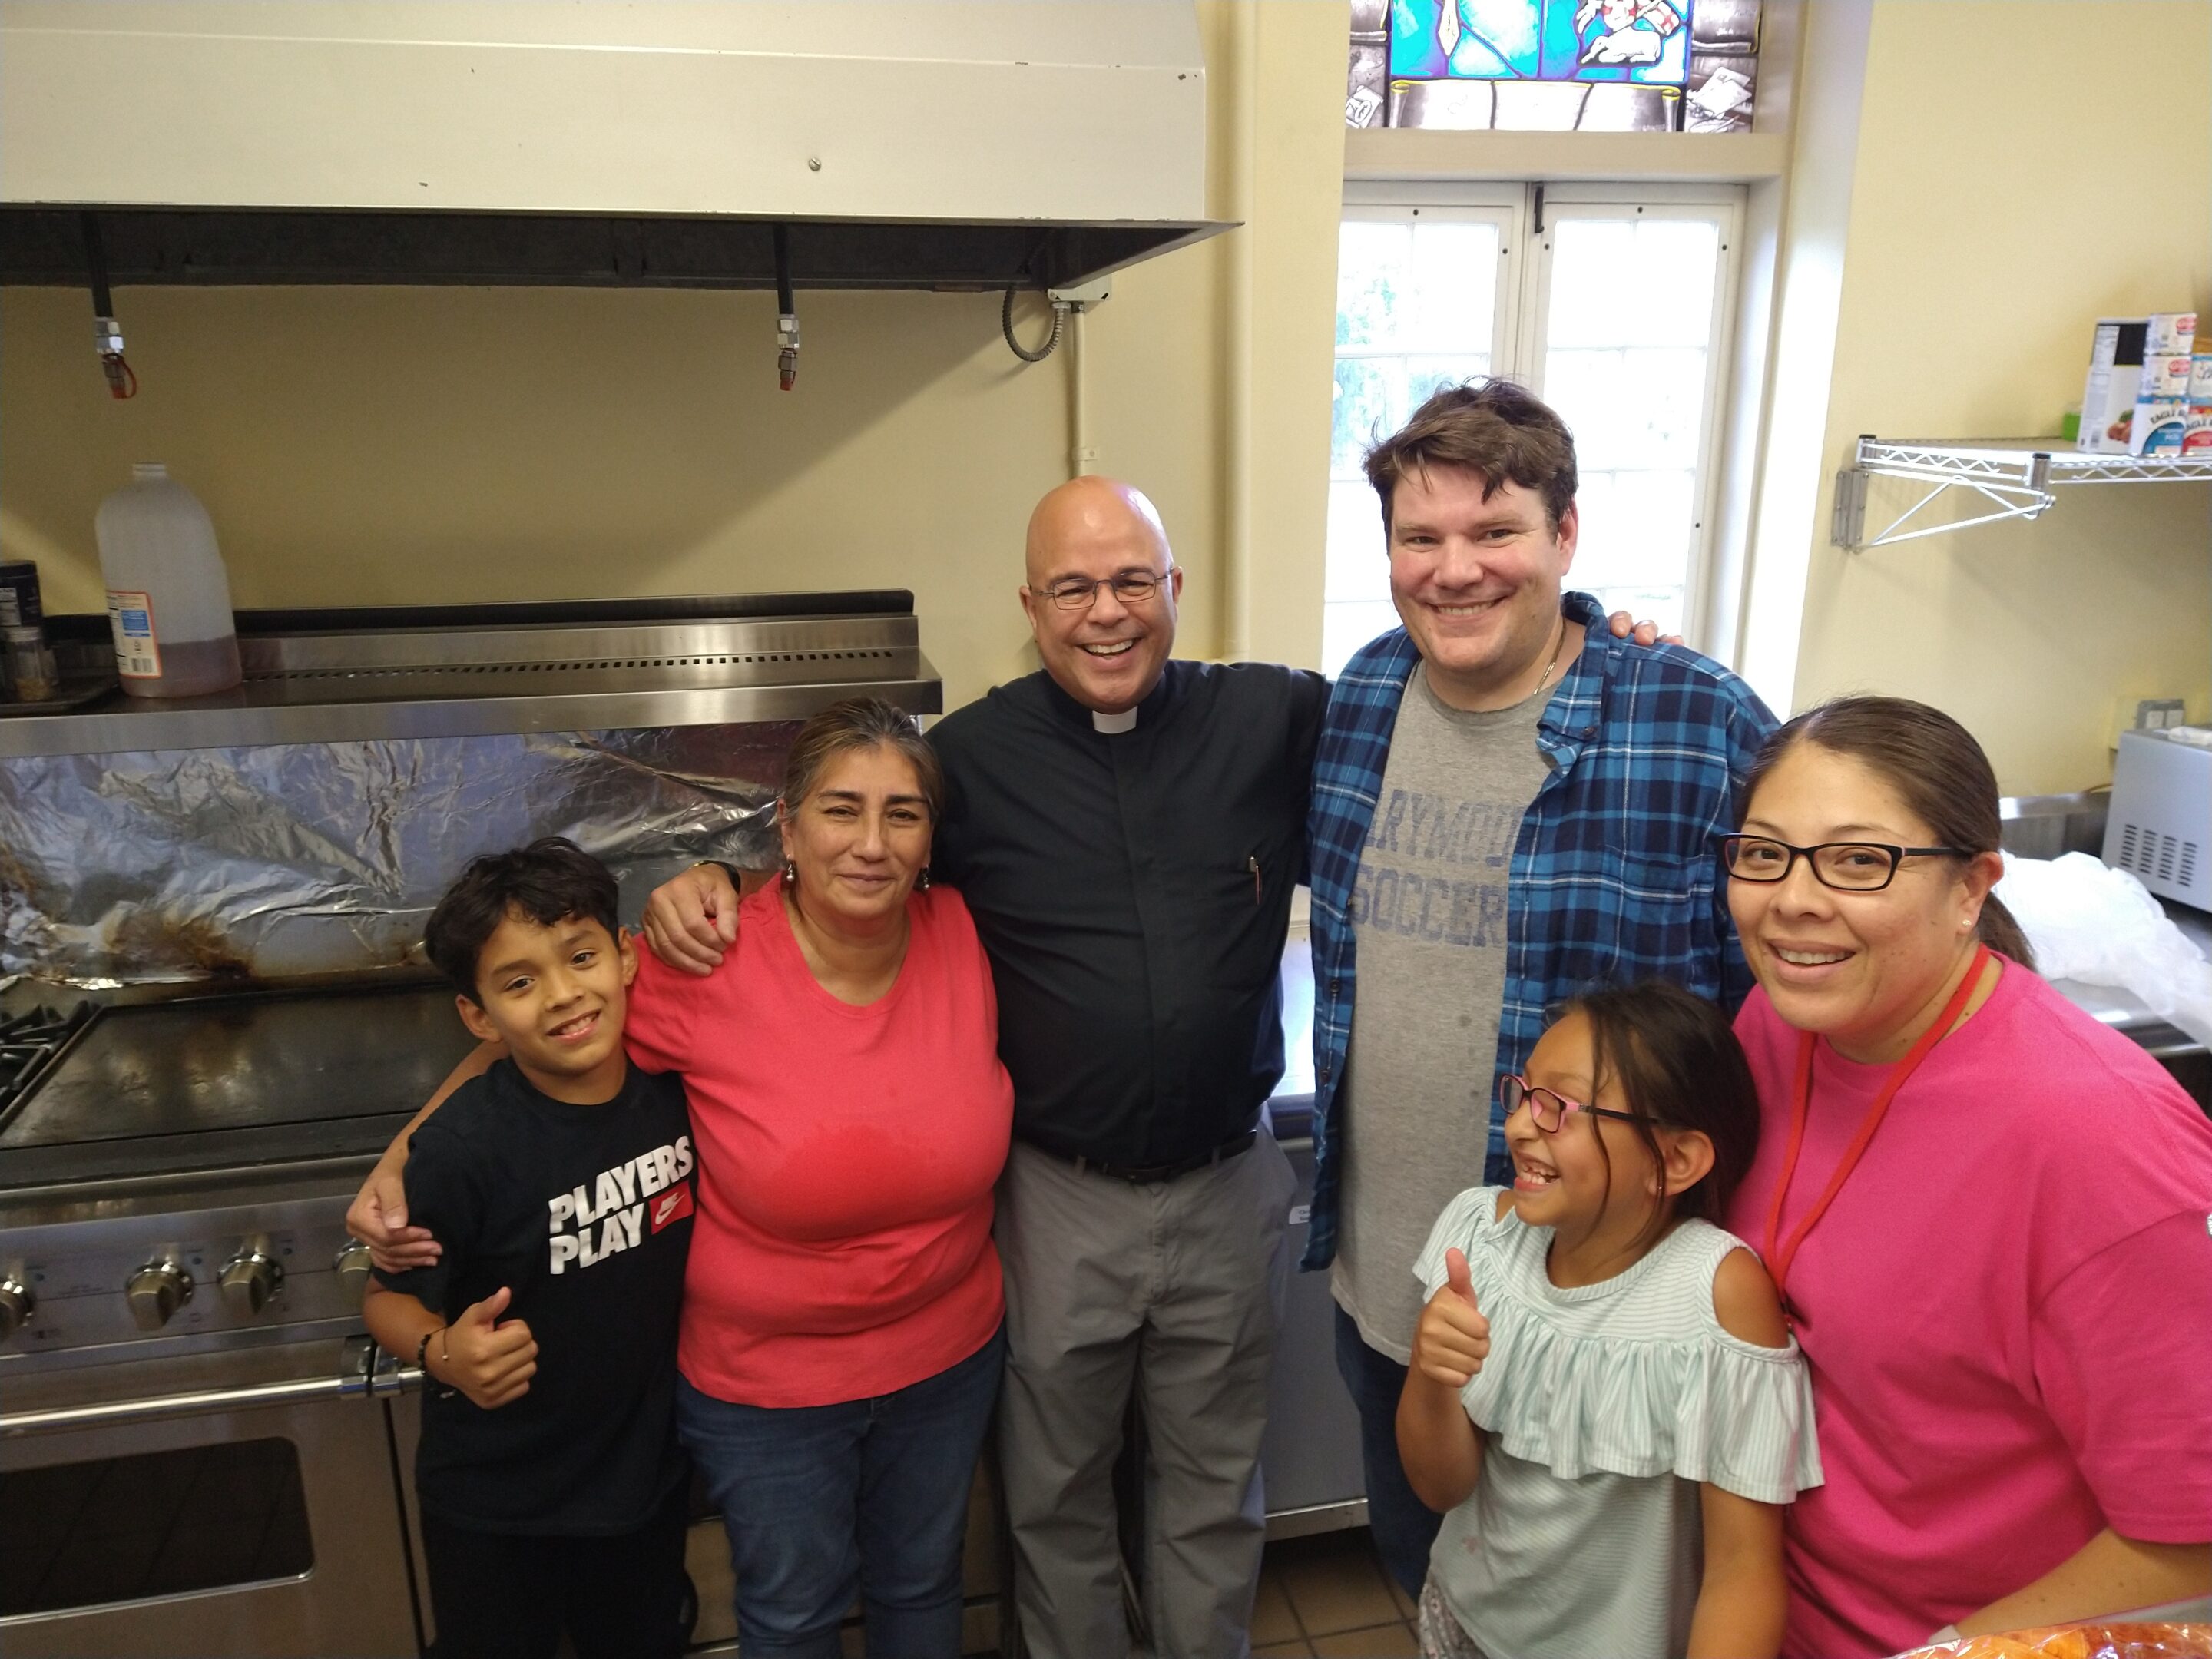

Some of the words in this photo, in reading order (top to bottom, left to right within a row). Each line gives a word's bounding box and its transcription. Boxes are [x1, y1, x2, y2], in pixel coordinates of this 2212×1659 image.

[1352, 863, 1507, 948] SOCCER
[548, 1135, 693, 1234] PLAYERS
[549, 1202, 644, 1275] PLAY
